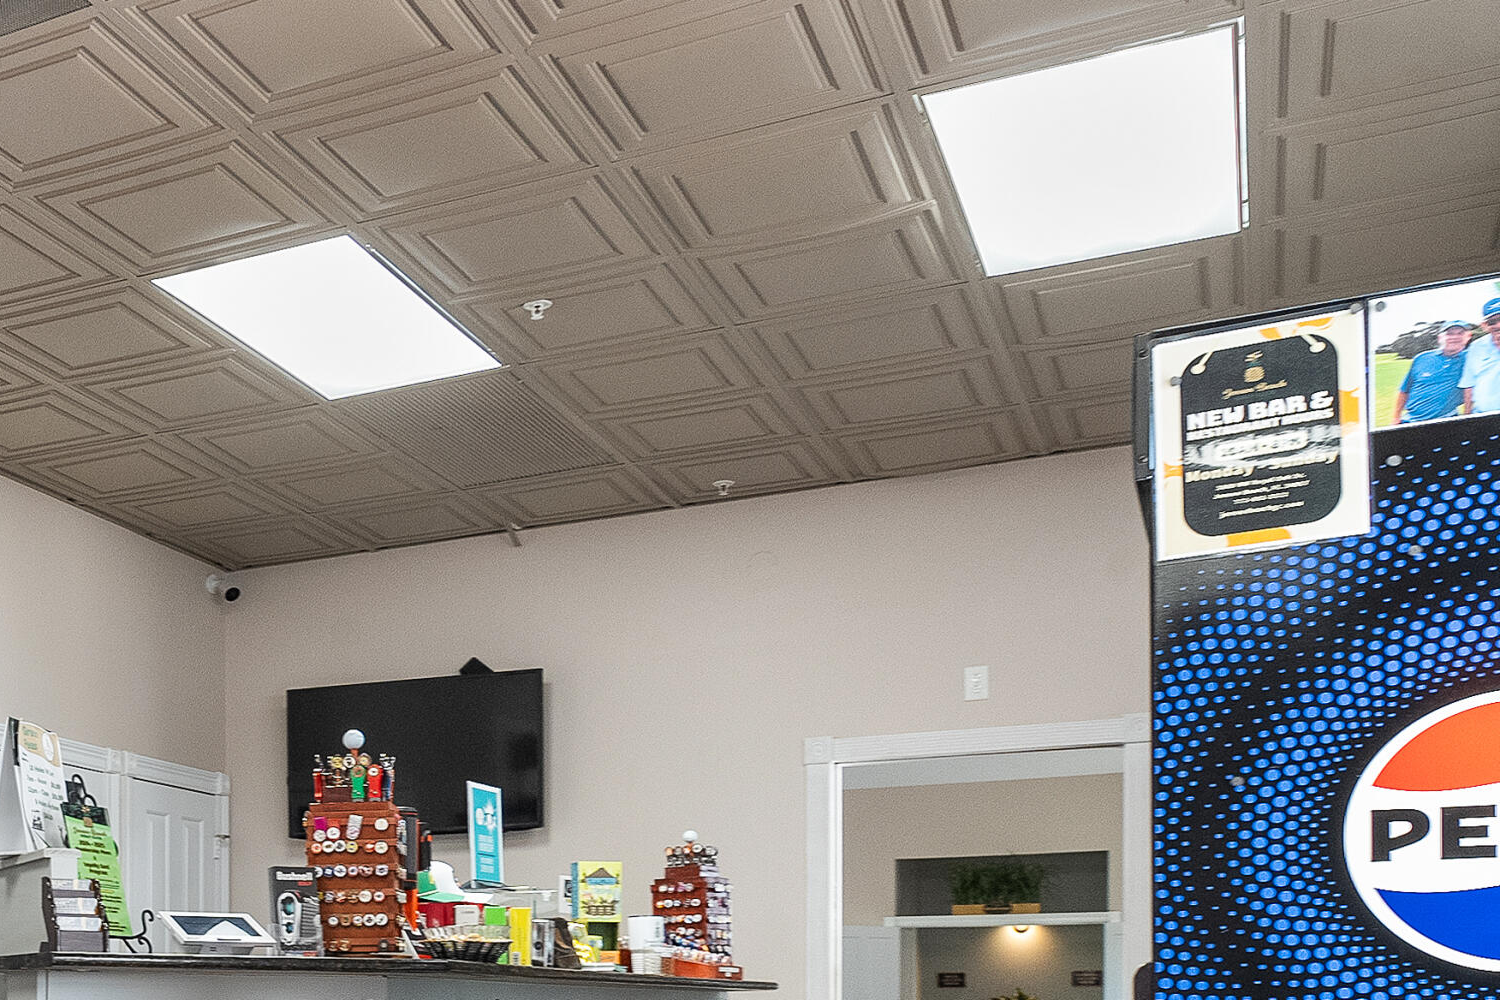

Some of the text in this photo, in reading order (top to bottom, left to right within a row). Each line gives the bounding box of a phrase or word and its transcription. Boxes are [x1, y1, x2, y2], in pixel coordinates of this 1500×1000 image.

[1186, 390, 1334, 431] NEW BAR &
